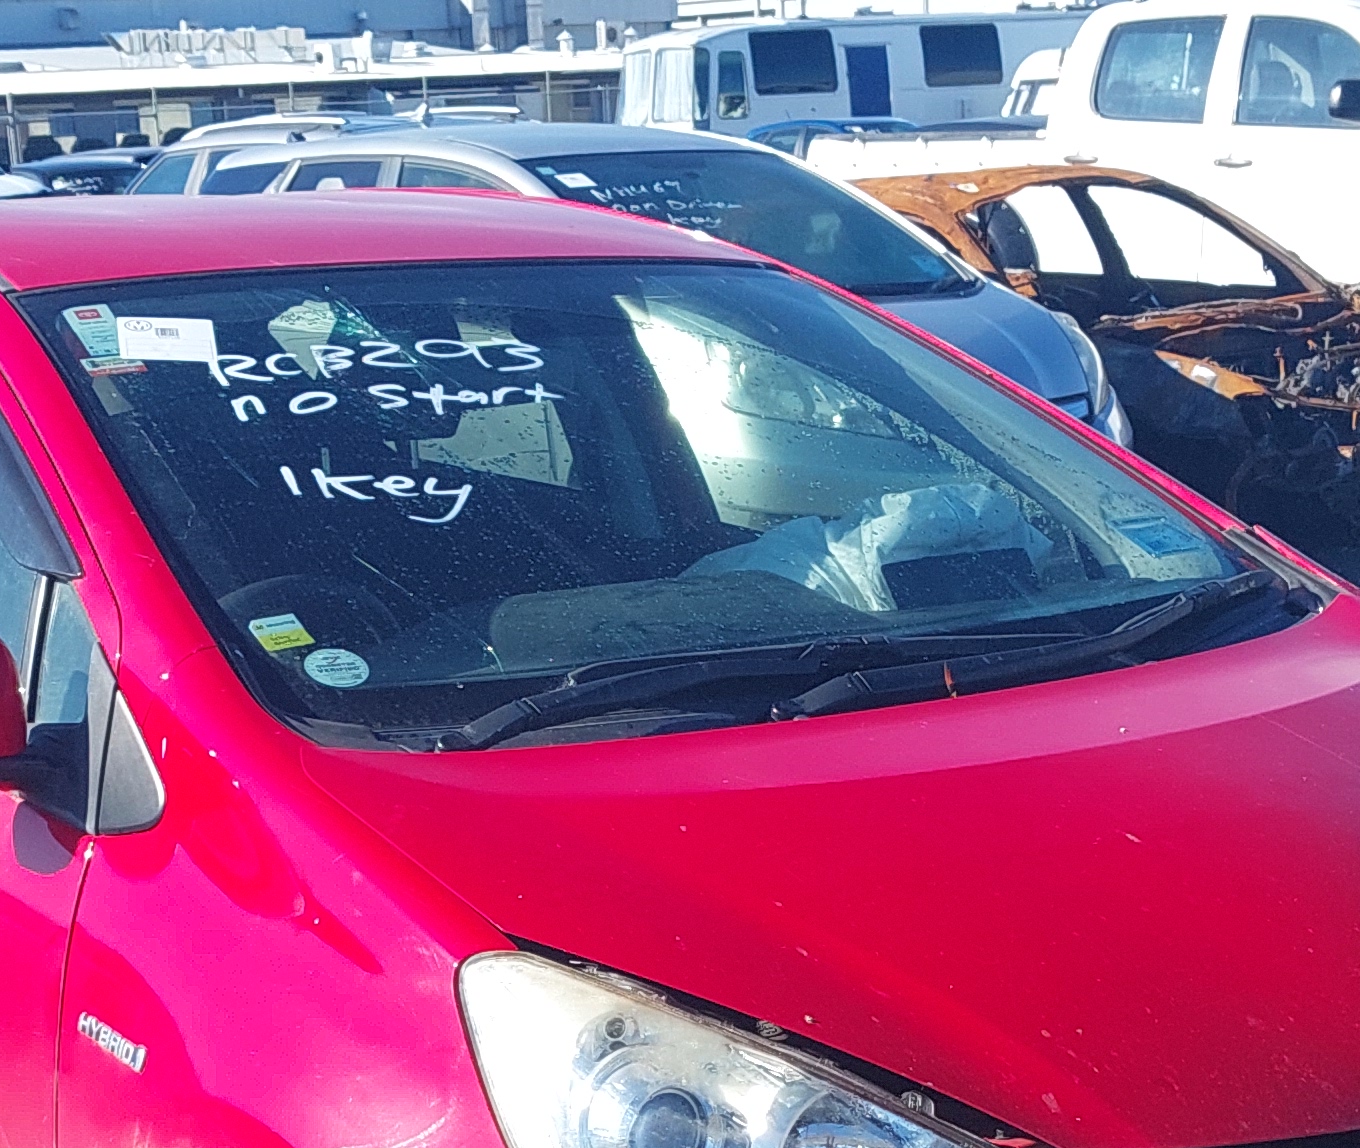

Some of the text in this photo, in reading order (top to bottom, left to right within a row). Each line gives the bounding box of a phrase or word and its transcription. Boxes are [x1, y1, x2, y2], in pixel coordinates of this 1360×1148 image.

[208, 337, 545, 387] RCB293
[230, 391, 338, 422] no
[78, 1012, 136, 1065] HYBRID
